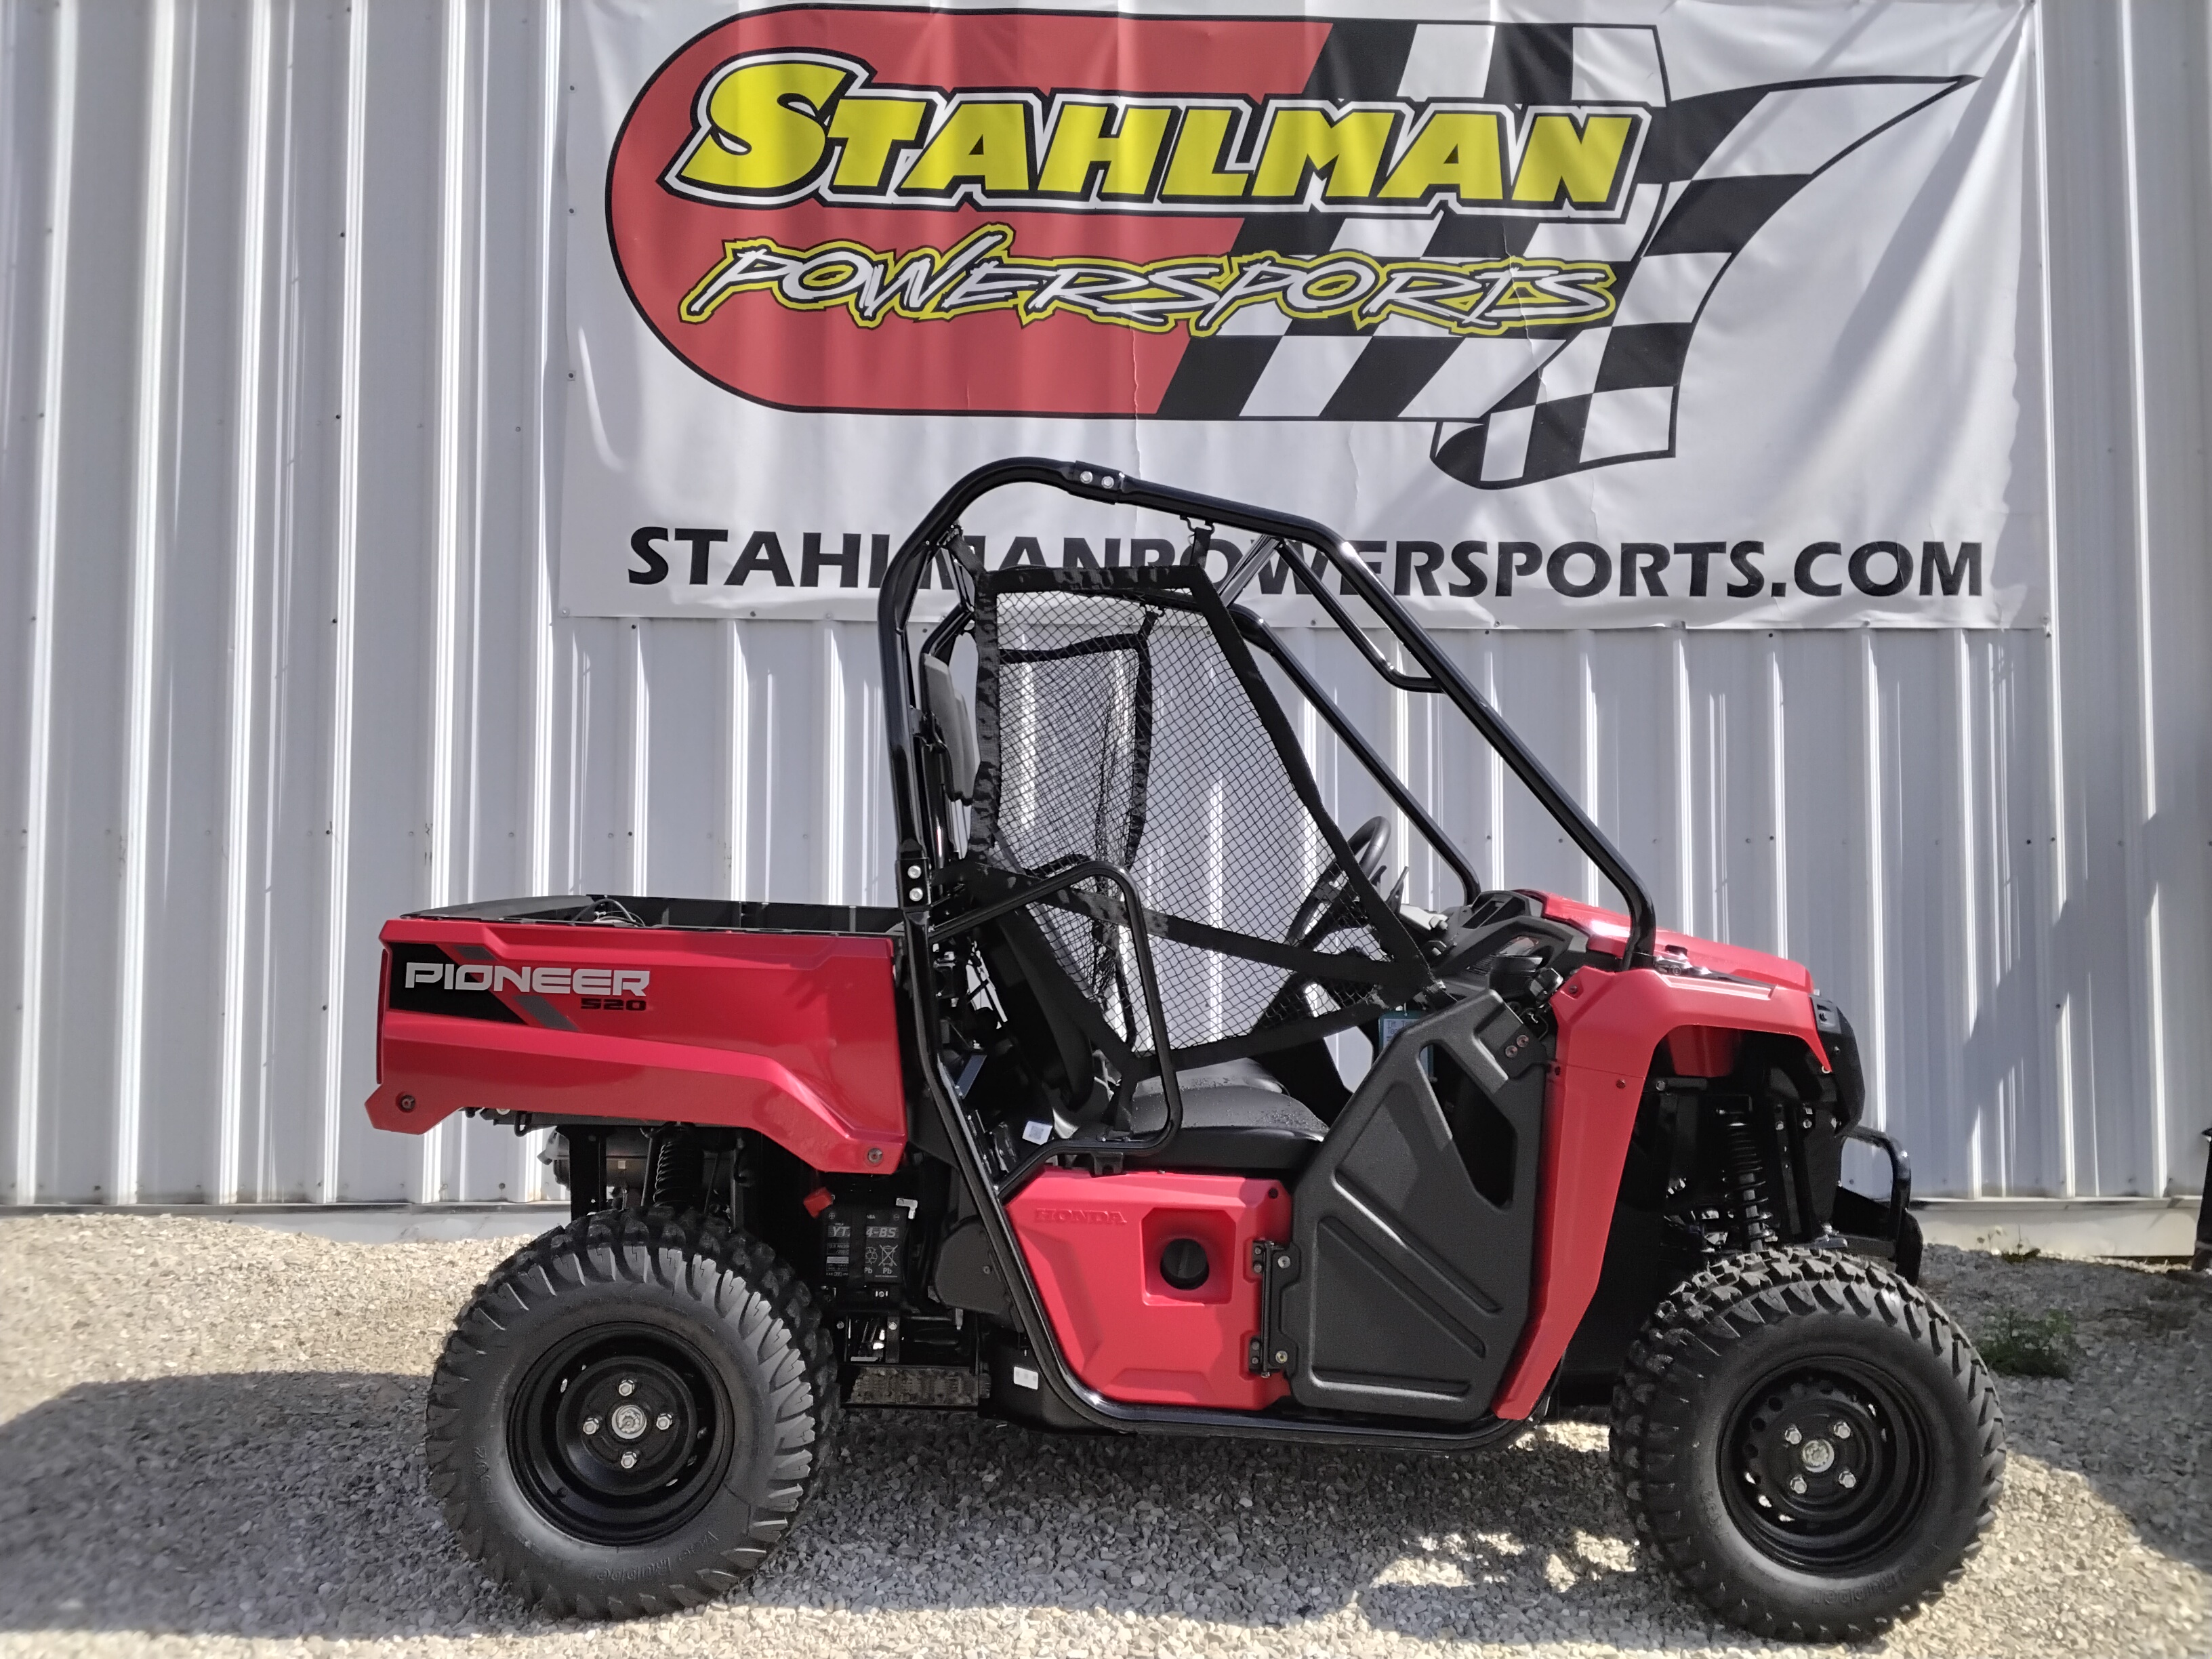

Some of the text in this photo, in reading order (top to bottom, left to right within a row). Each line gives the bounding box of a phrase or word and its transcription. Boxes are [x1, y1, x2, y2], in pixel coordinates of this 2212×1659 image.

[668, 56, 1643, 216] STAHLMAN
[682, 225, 1617, 332] POWERSPORTS
[405, 962, 650, 997] PIONEER
[581, 998, 646, 1011] 520
[1035, 1208, 1127, 1225] HONDA
